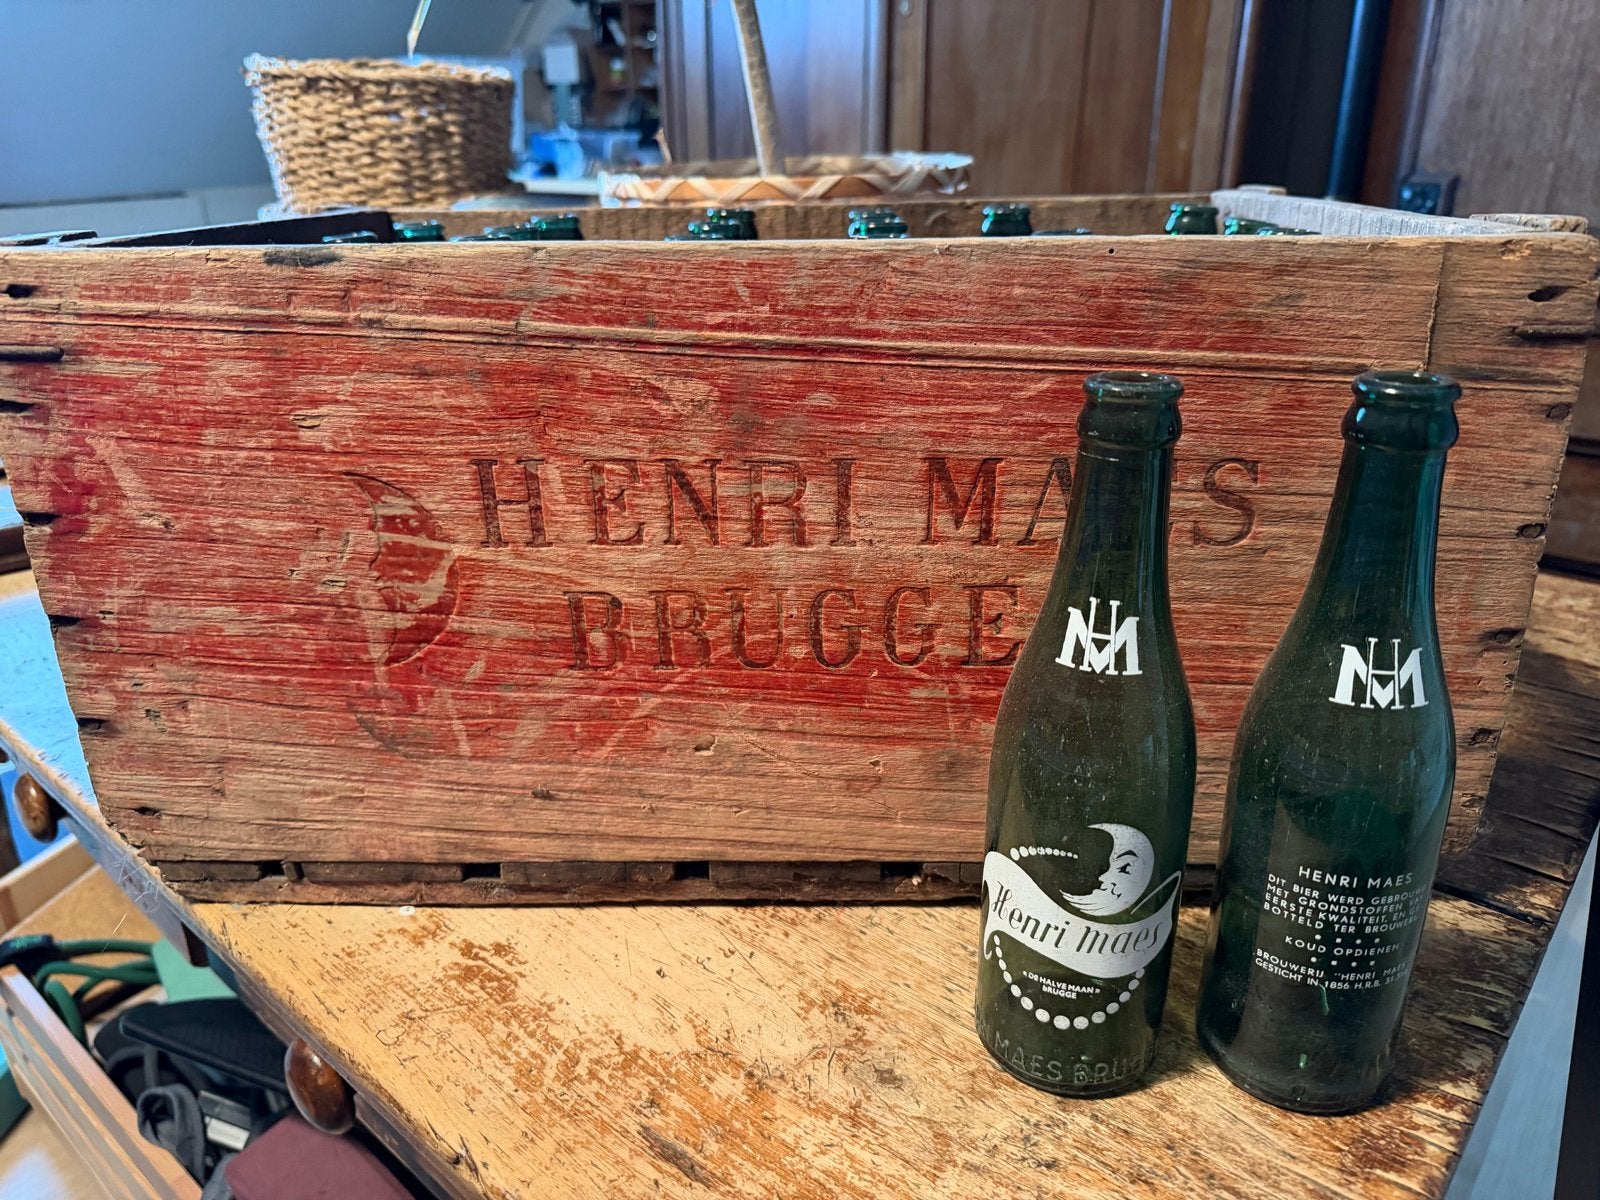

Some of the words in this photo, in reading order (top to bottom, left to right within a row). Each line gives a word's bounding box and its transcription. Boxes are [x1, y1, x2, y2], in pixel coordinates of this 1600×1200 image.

[470, 456, 860, 549] HENRI
[923, 456, 1261, 549] MAS
[563, 584, 1024, 672] BRUGGE
[1268, 873, 1287, 888] DIT
[1292, 883, 1320, 900] BIER
[1327, 893, 1365, 906] WERD
[1298, 865, 1358, 889] HENRI
[1367, 871, 1413, 889] MAES
[991, 880, 1070, 949] Henri
[1265, 892, 1313, 917] EERSTE
[1392, 910, 1406, 922] EN
[1266, 882, 1290, 899] MET
[1298, 895, 1403, 914] GRONDSTOFFEN
[1263, 901, 1324, 929] BOTTELD
[1333, 923, 1356, 934] TER
[1256, 947, 1325, 978] BROUWERIJ
[1285, 935, 1327, 954] KOUD
[1333, 943, 1400, 957] OPDIENEN
[1039, 976, 1067, 990] HALVE
[1255, 957, 1303, 982] GESTICHT
[1307, 977, 1319, 987] IN
[1324, 980, 1350, 990] 1856
[1354, 979, 1381, 990] H.R.B.
[995, 1029, 1063, 1081] MAES
